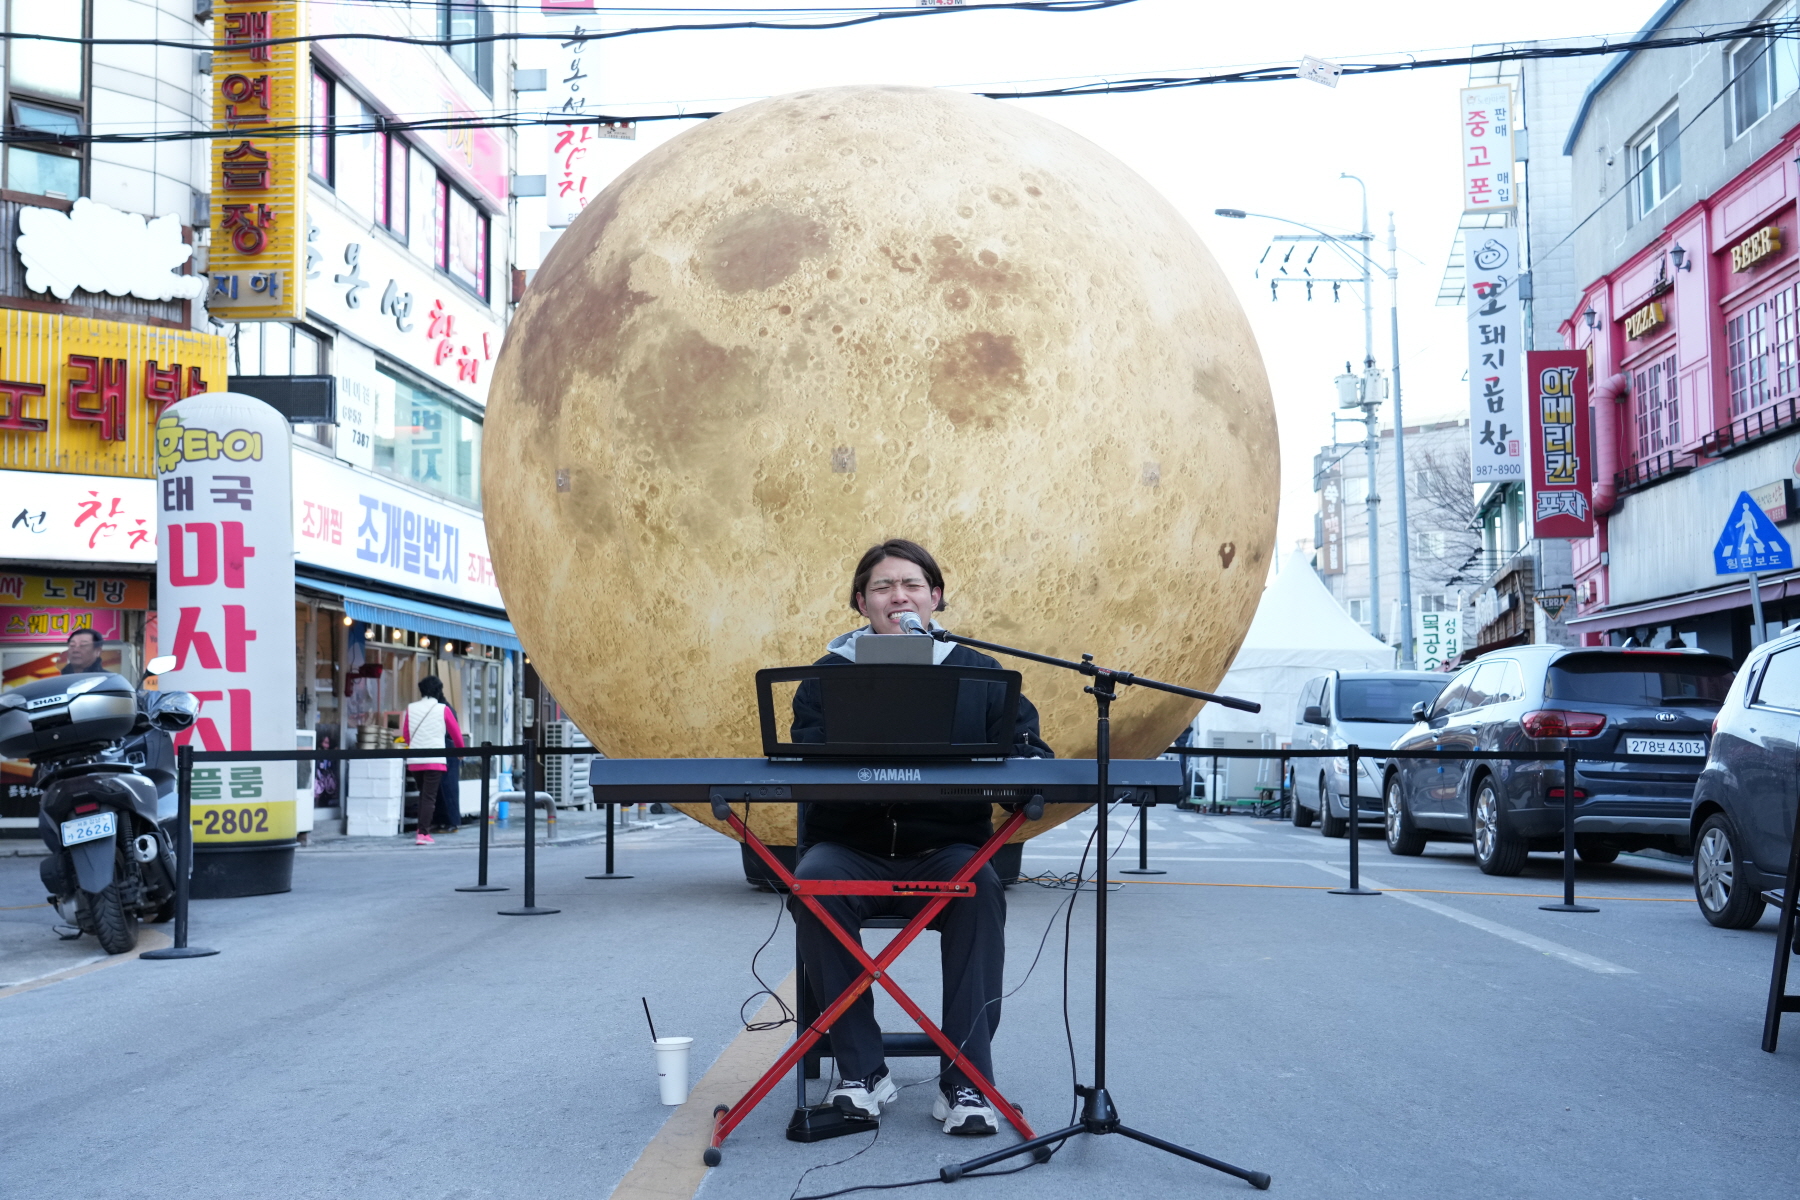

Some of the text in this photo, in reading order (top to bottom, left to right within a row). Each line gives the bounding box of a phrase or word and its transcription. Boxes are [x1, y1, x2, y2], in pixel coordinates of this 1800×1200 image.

[221, 0, 275, 256] 래연습장
[1494, 108, 1507, 136] 판매
[1466, 110, 1492, 204] 중고폰
[1497, 172, 1509, 202] 매입
[1731, 226, 1776, 274] BEER
[1625, 302, 1659, 342] PIZZA
[1540, 367, 1579, 485] 아메리칸
[1476, 464, 1521, 476] 987-8900
[163, 476, 254, 512] 태국
[1536, 490, 1589, 522] 포차
[302, 494, 499, 588] 조개찜 조개일번지 조개구
[1726, 555, 1781, 569] 횡단보도
[43, 579, 127, 604] 노래방
[1539, 597, 1565, 608] TERRA
[6, 612, 93, 634] 스웨디시
[1445, 618, 1457, 658] 성실
[168, 521, 257, 756] 마사지
[33, 696, 62, 706] SHAD
[1660, 713, 1675, 721] KIA
[1632, 740, 1700, 754] 278보 4303
[177, 766, 263, 800] 플룸
[873, 768, 921, 781] YAMAHA
[76, 822, 111, 839] 2626
